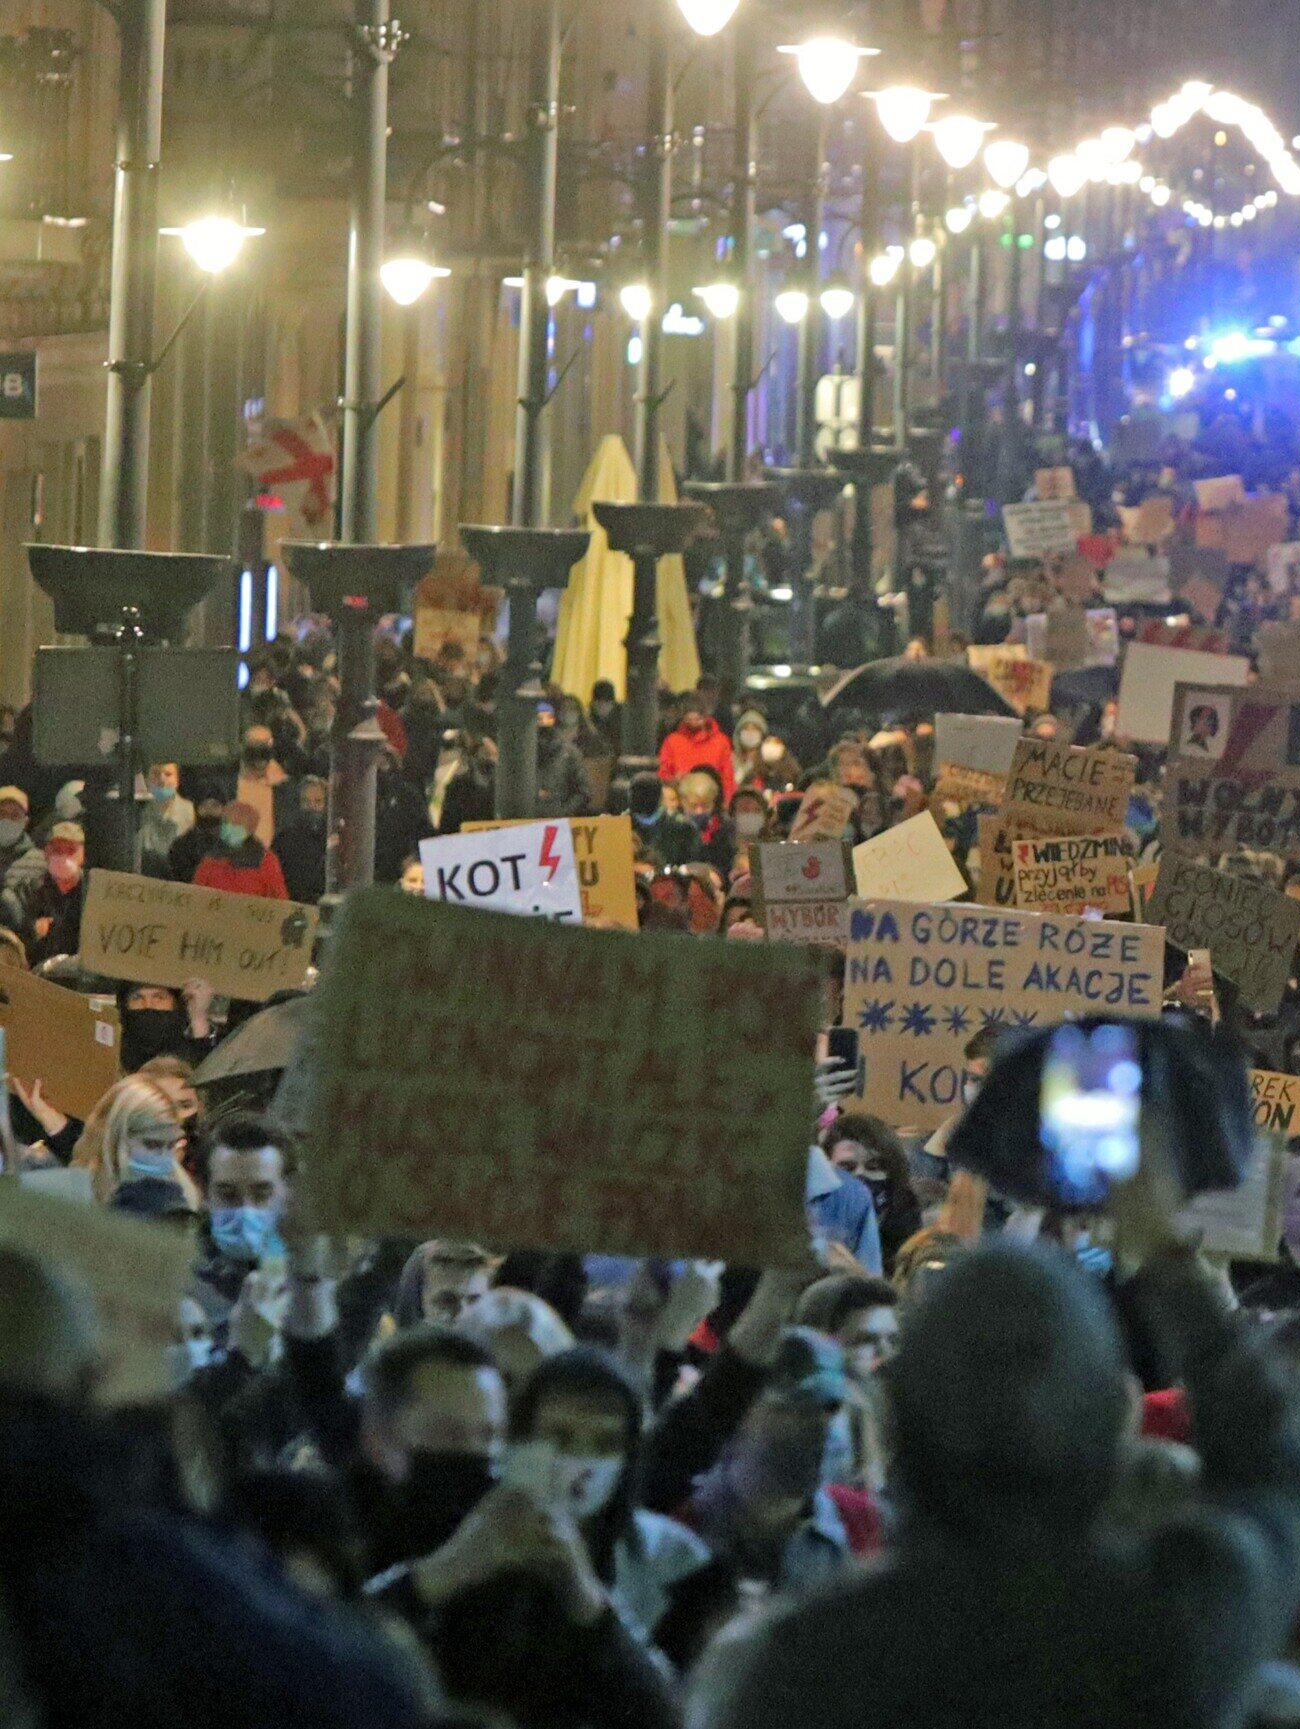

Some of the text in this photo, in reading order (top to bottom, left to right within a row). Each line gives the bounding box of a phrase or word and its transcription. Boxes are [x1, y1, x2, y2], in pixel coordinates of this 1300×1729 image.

[1017, 748, 1106, 785] MACIE
[436, 854, 526, 901] KOT
[98, 922, 168, 959] VOTE
[178, 930, 225, 966] HIM
[850, 909, 899, 943] NA
[911, 908, 1021, 949] GÓRZE
[850, 955, 1151, 1005] NA DOLE AKACJE
[899, 1058, 968, 1104] KO
